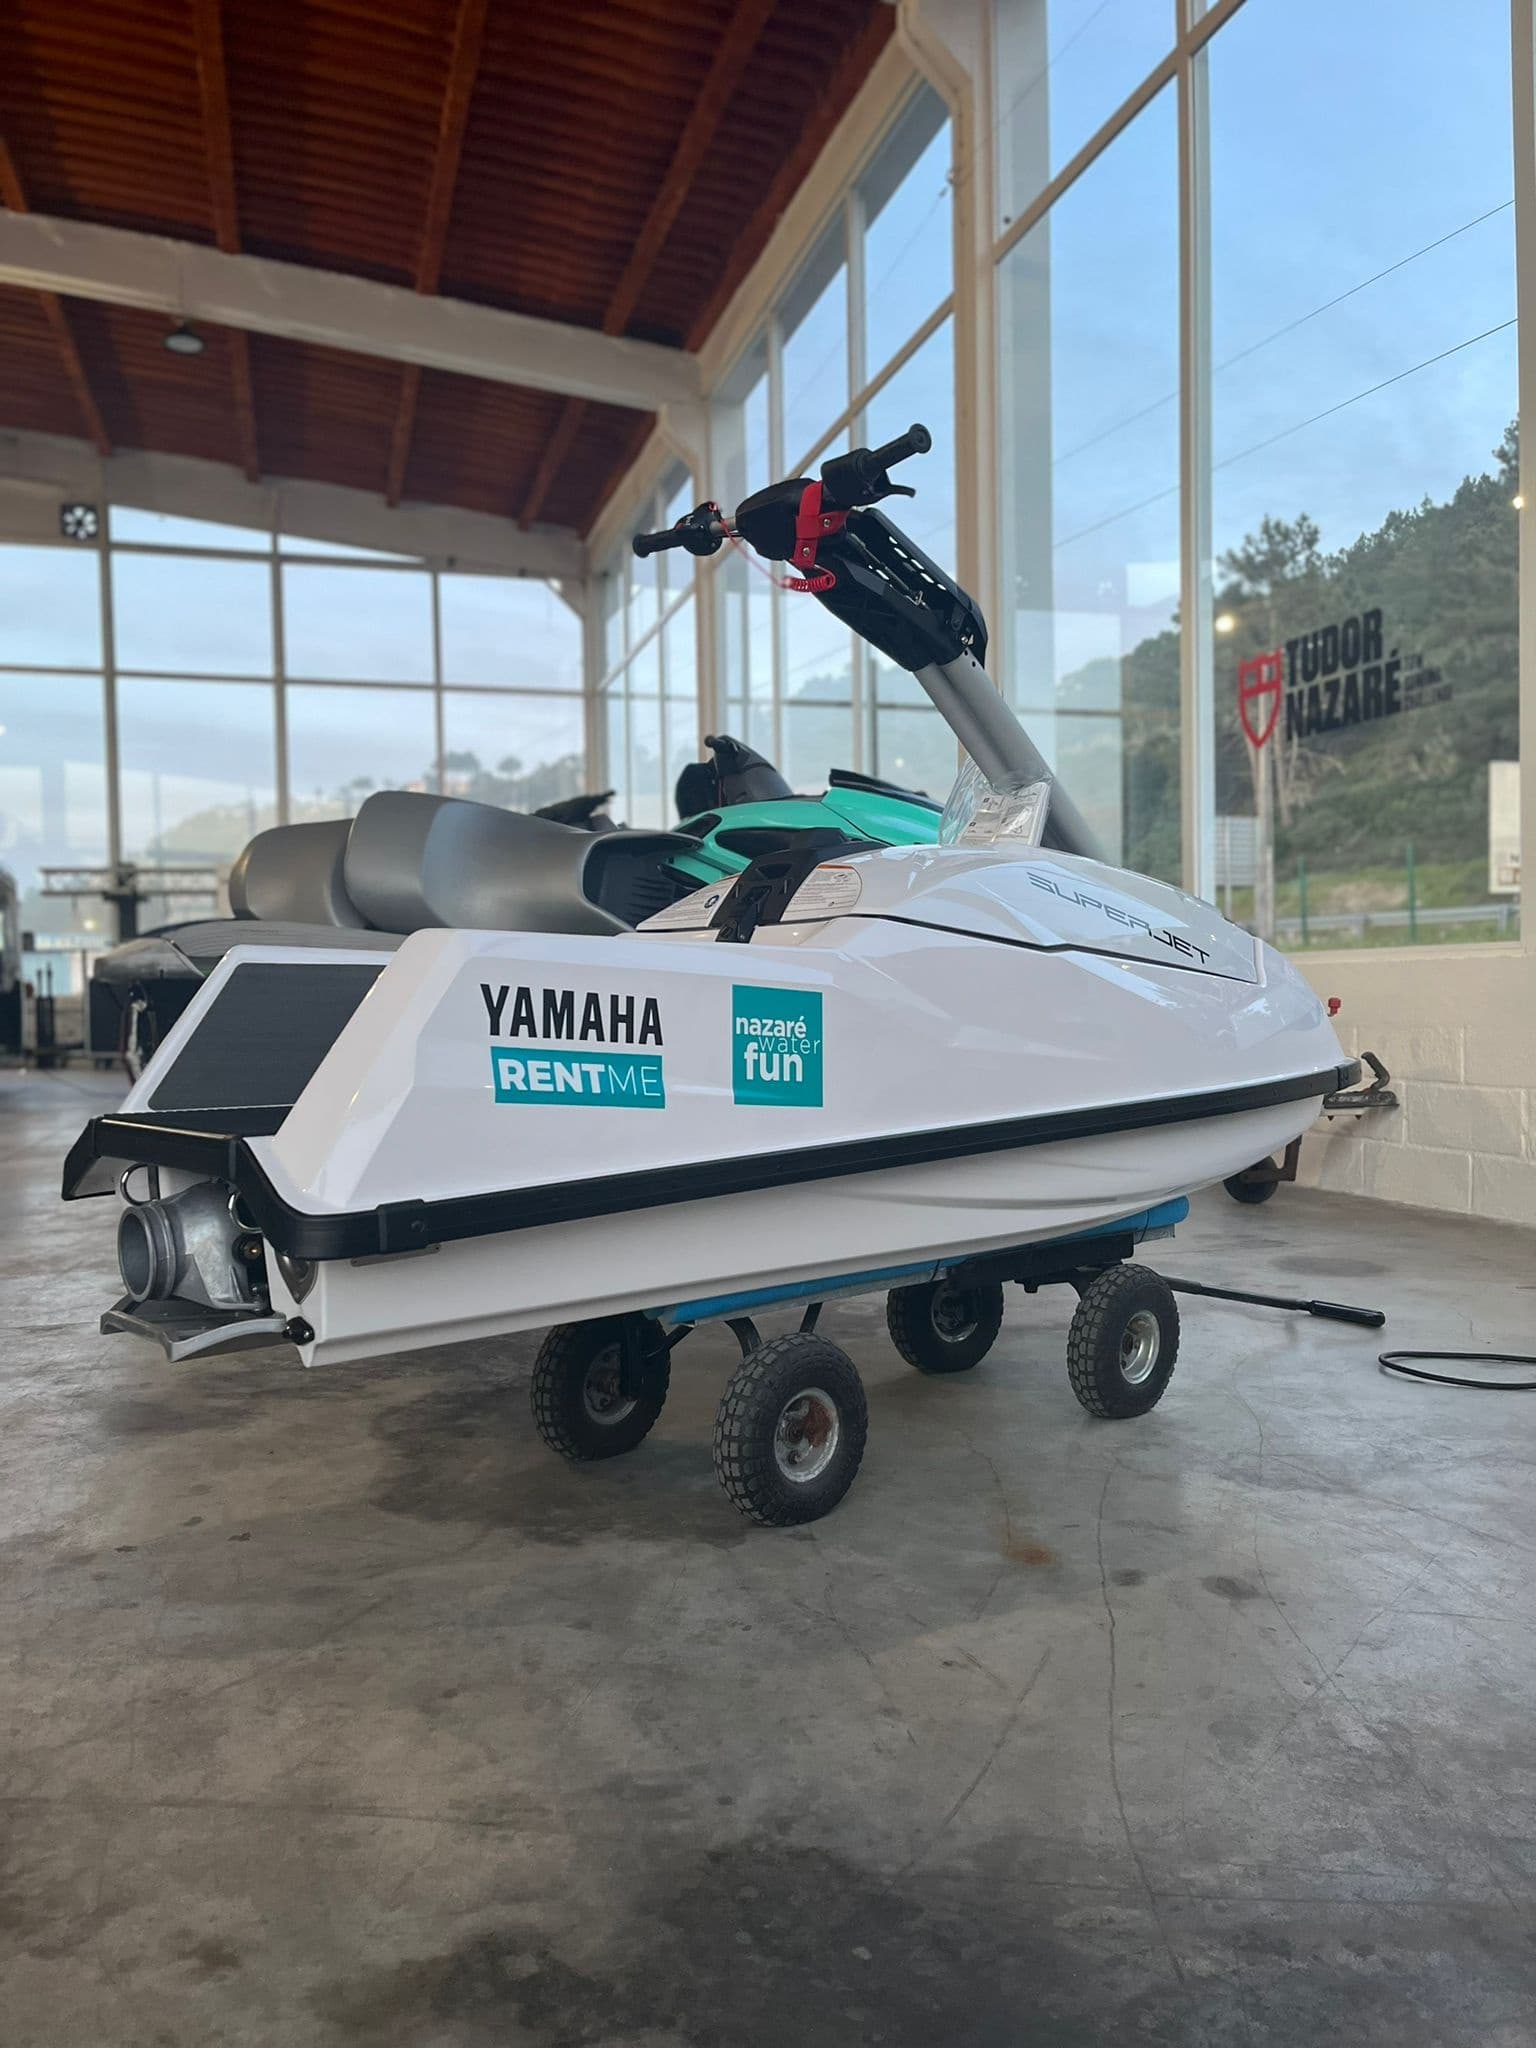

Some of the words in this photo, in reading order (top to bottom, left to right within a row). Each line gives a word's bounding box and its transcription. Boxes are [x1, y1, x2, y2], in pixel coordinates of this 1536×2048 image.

[1286, 608, 1383, 687] TUDOR
[1286, 648, 1401, 742] NAZARÉ
[480, 983, 664, 1046] YAMAHA
[736, 1015, 807, 1039] nazaré
[743, 1041, 803, 1082] fun
[758, 1034, 821, 1054] water
